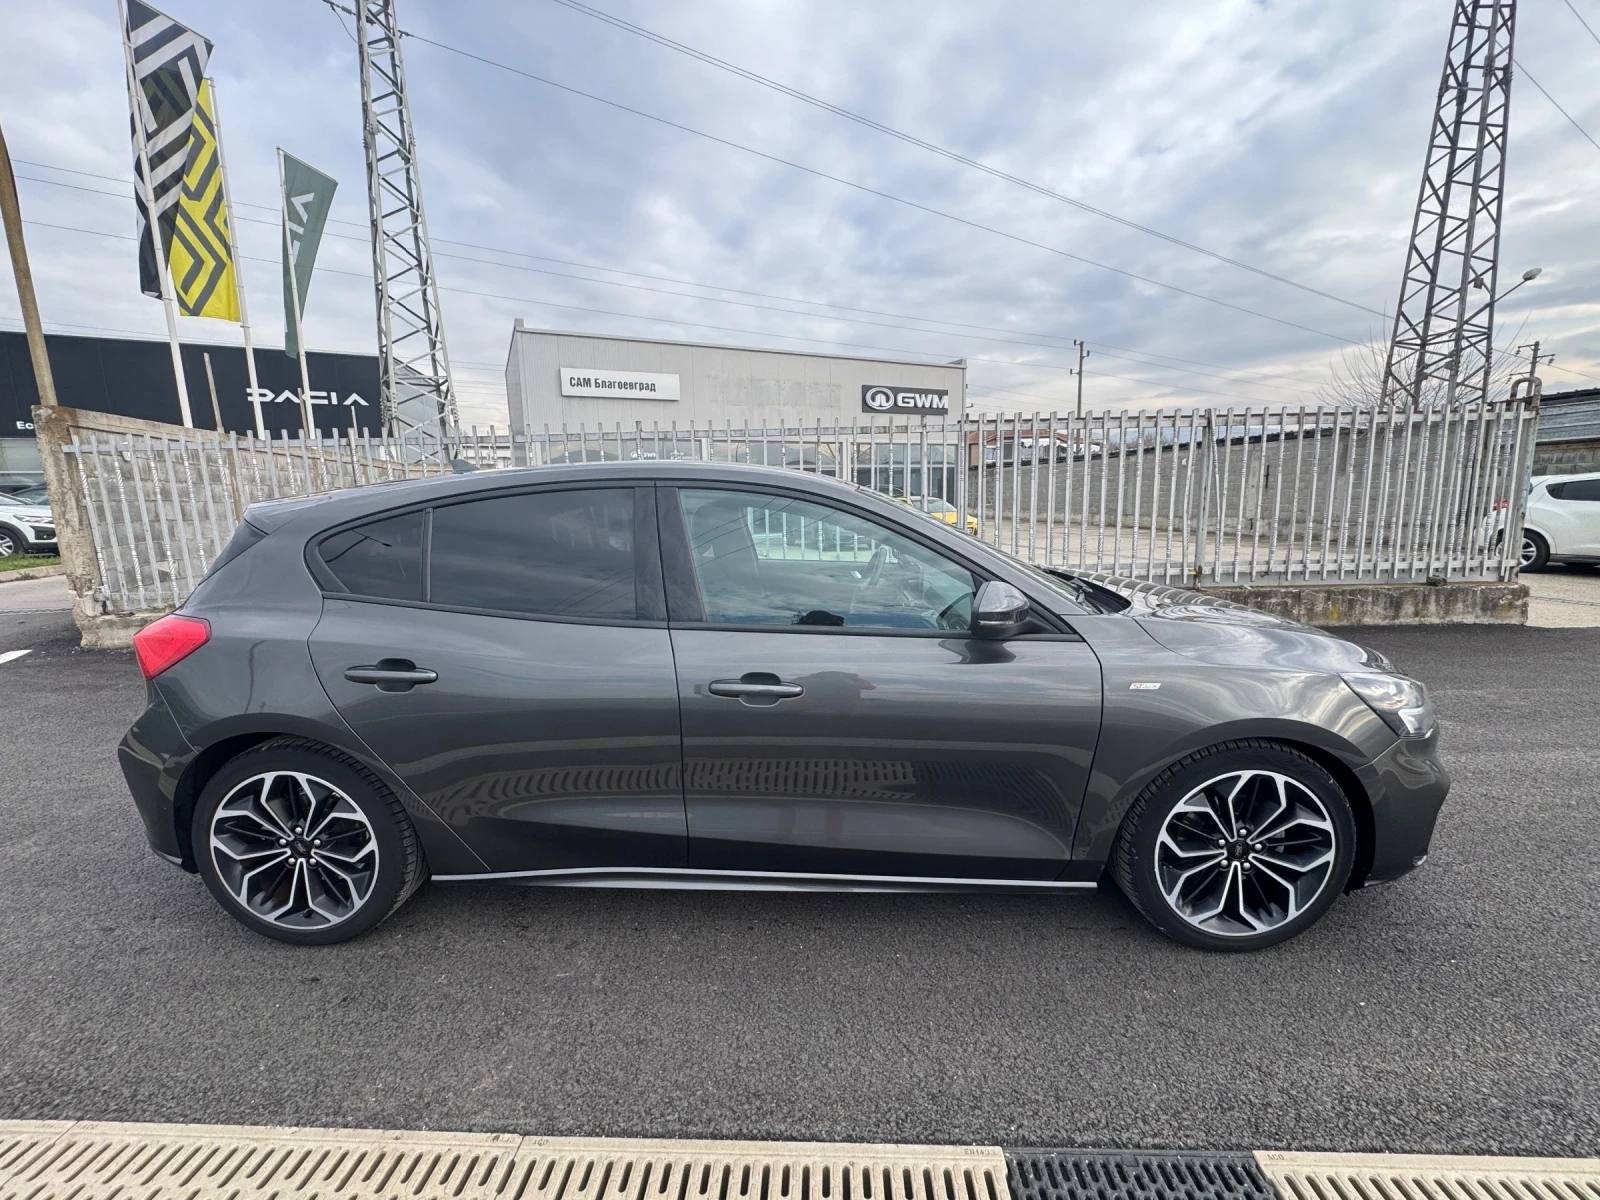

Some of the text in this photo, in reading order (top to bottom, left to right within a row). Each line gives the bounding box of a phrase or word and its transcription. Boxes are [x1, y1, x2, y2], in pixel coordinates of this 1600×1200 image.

[569, 376, 657, 392] САМ Благоевград
[896, 392, 948, 409] GWM
